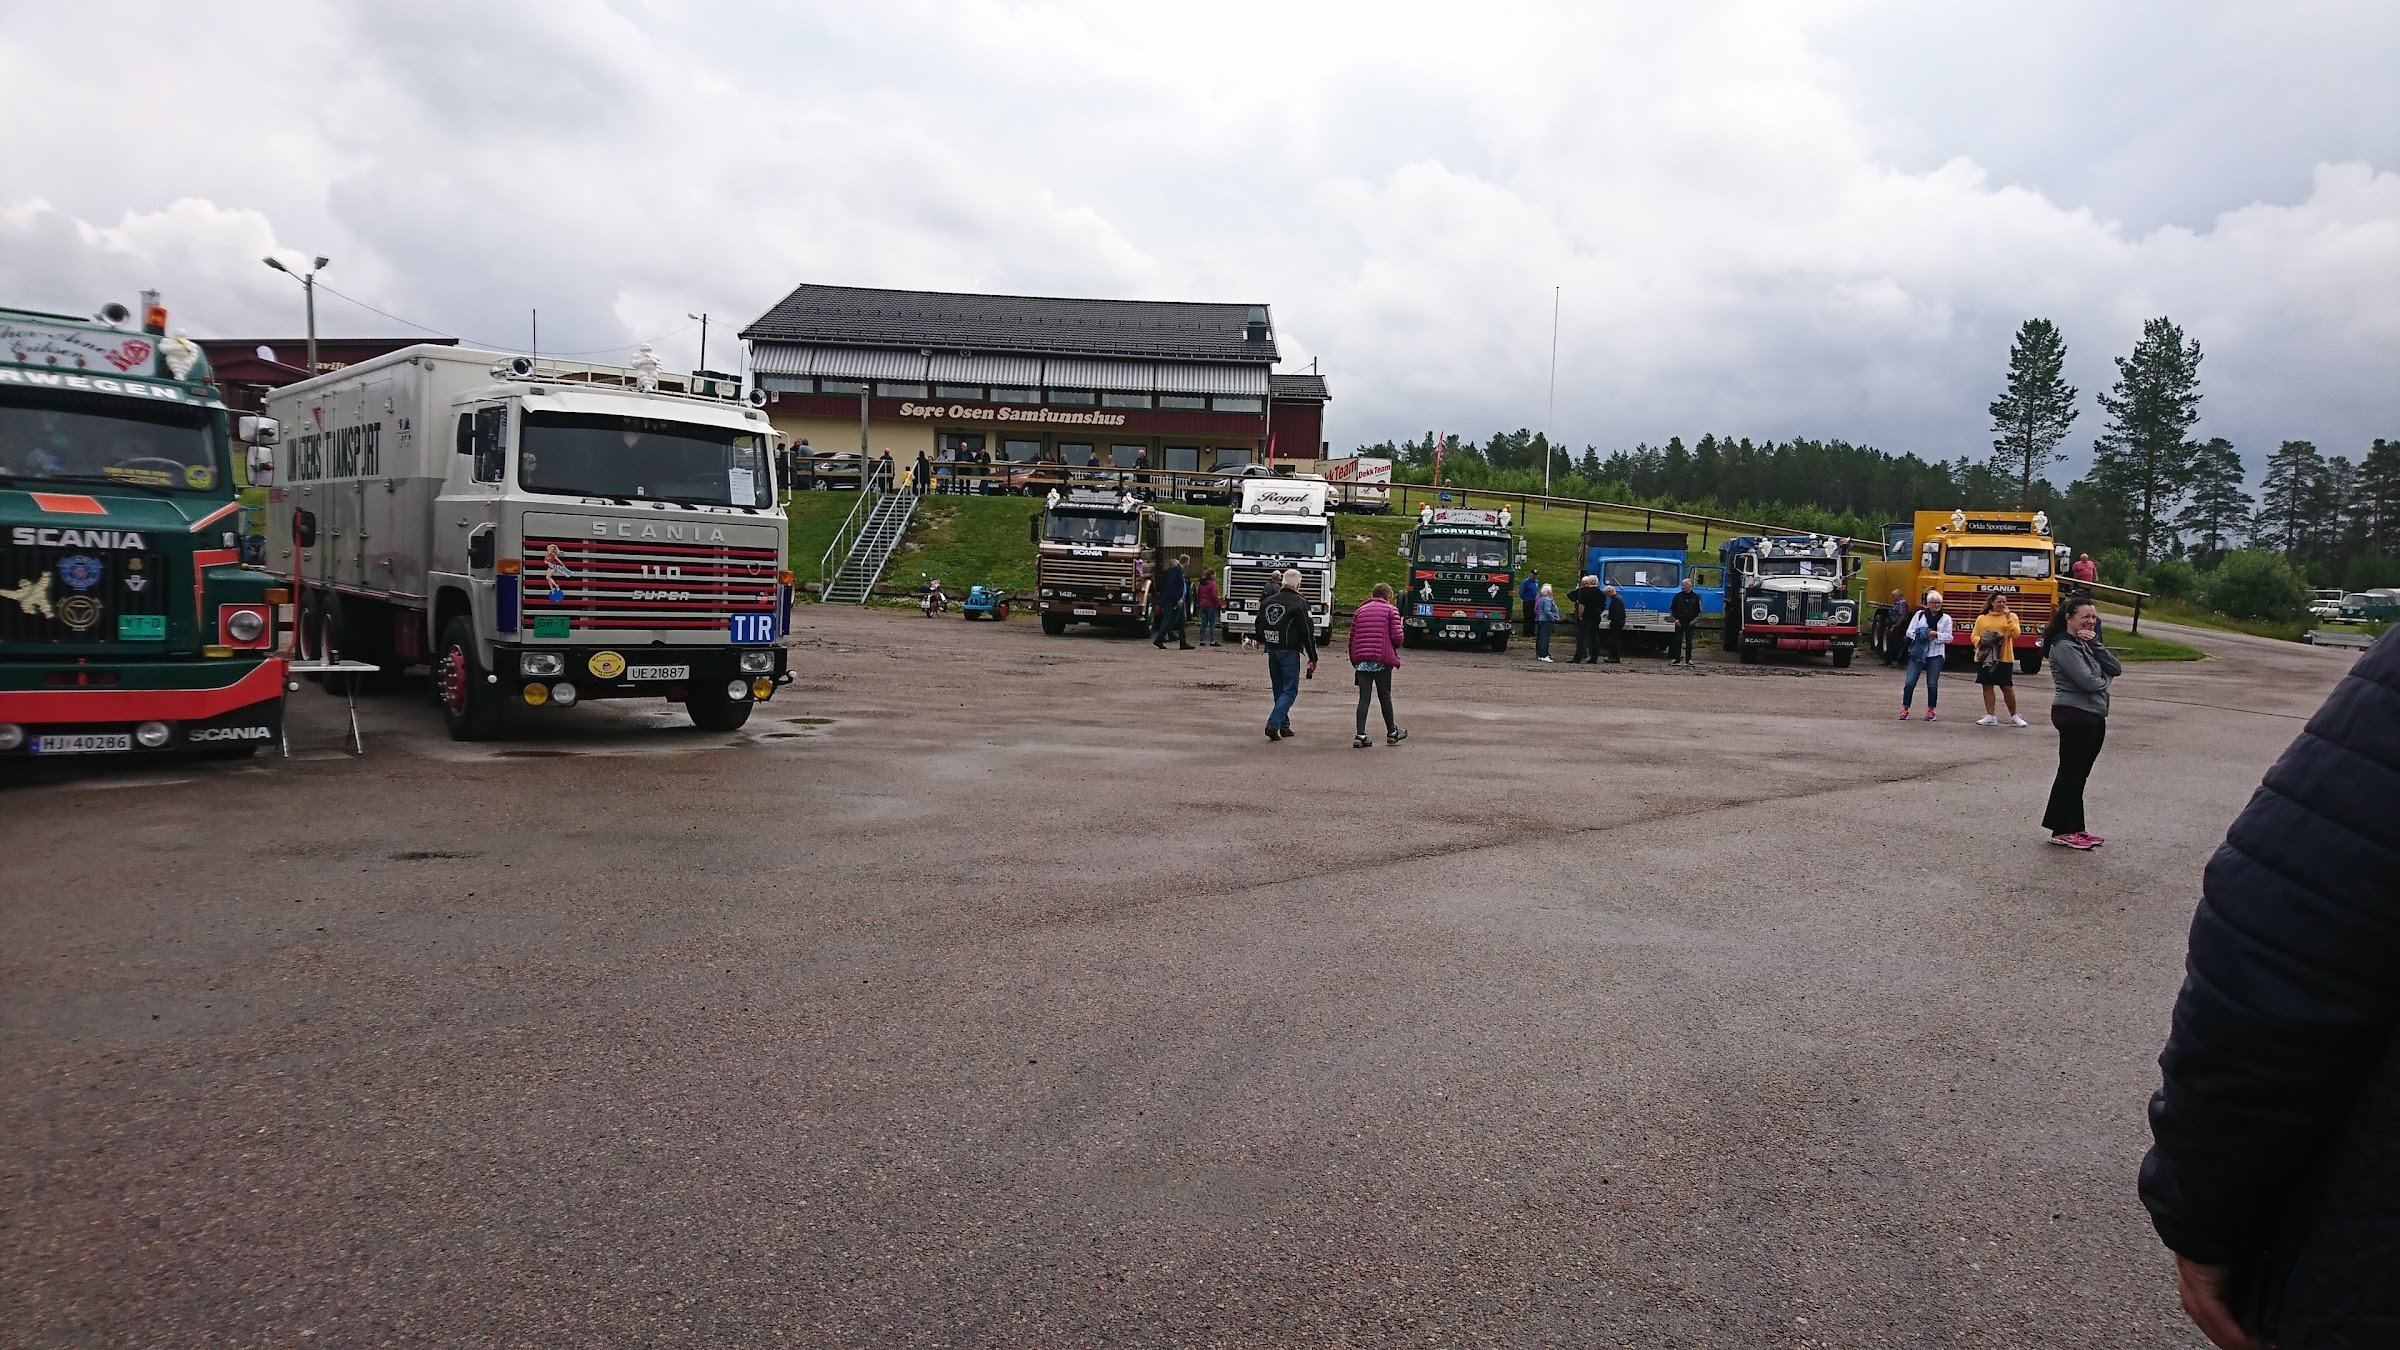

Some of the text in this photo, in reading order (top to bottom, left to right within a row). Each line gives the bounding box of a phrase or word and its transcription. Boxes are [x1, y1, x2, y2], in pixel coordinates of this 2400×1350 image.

[899, 402, 1125, 426] Søre Osen Samfunnshus
[1258, 491, 1310, 505] Royal
[13, 527, 145, 550] SCANIA
[592, 521, 725, 542] SCANIA
[1434, 528, 1498, 536] NORWEGEN
[1073, 549, 1103, 557] SCANIA
[640, 565, 681, 580] 110
[1437, 572, 1487, 580] SCANIA
[632, 590, 690, 601] SUPER
[735, 615, 772, 641] TIR
[632, 668, 648, 678] UE
[650, 667, 685, 678] 21887
[189, 726, 271, 742] SCANIA
[43, 736, 127, 750] HJ 40286
